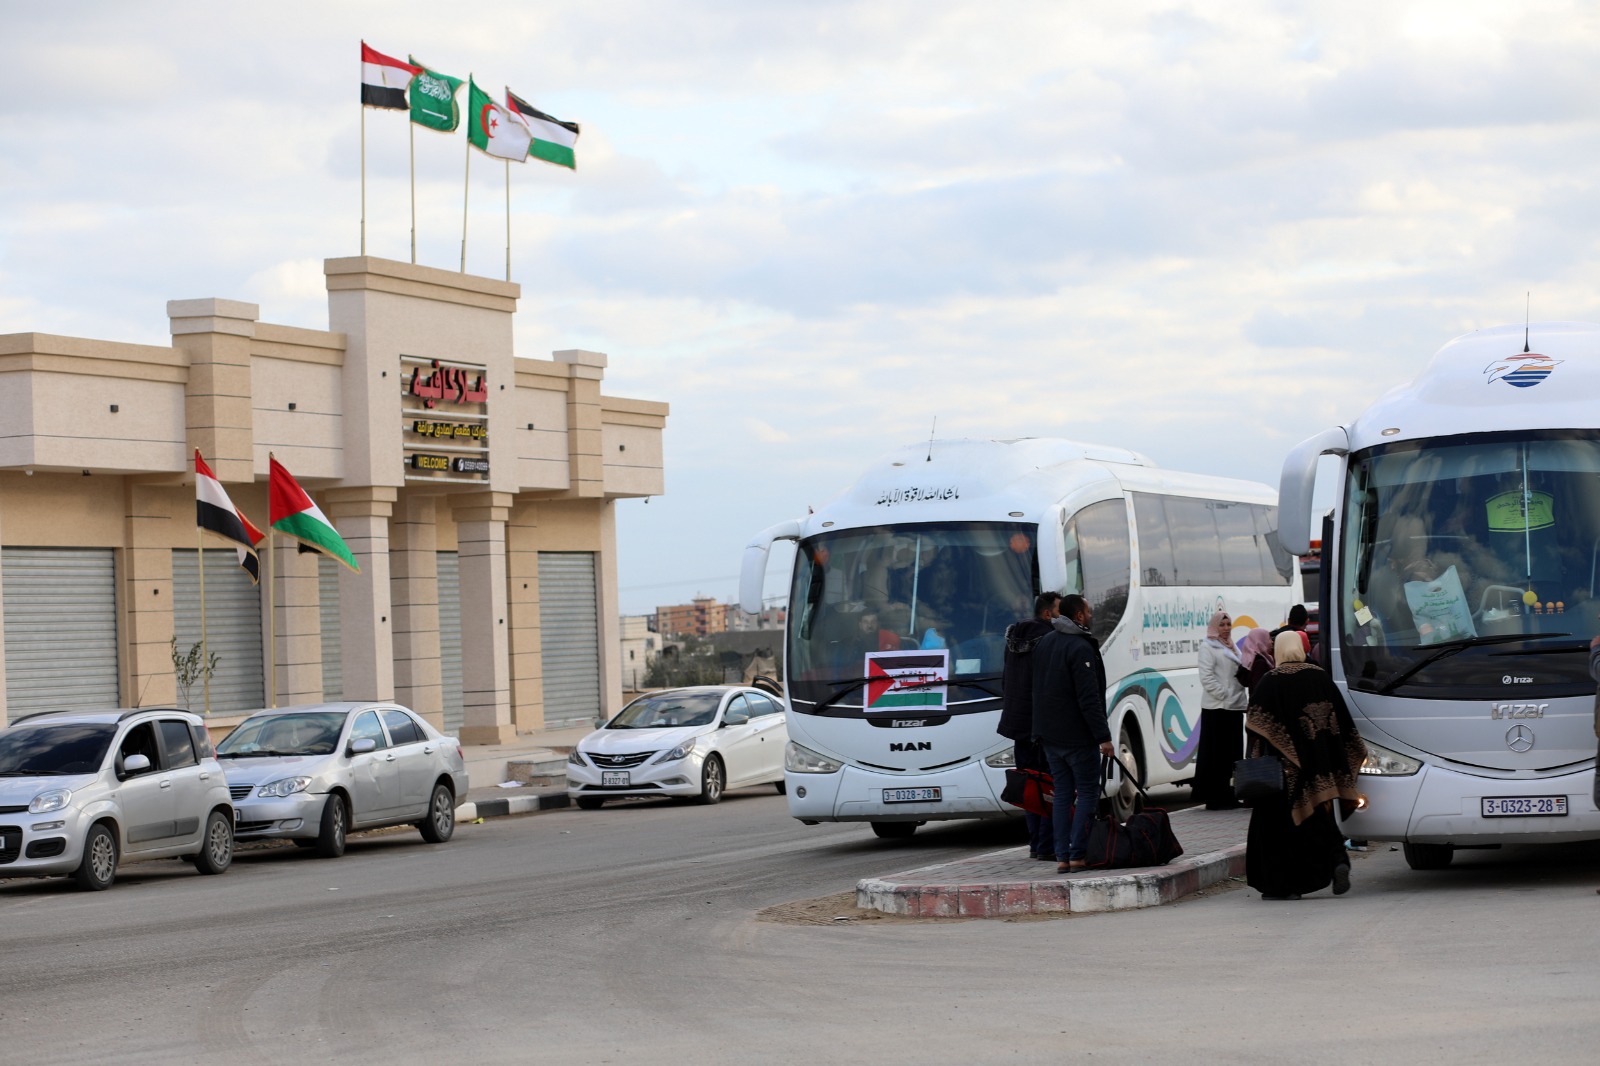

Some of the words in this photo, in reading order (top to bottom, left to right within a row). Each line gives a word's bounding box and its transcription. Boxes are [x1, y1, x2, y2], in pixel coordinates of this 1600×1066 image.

[418, 455, 448, 470] WELCOME
[889, 741, 932, 752] MAN
[884, 789, 932, 801] 3-0328-28
[1486, 799, 1554, 814] 3-0323-28
